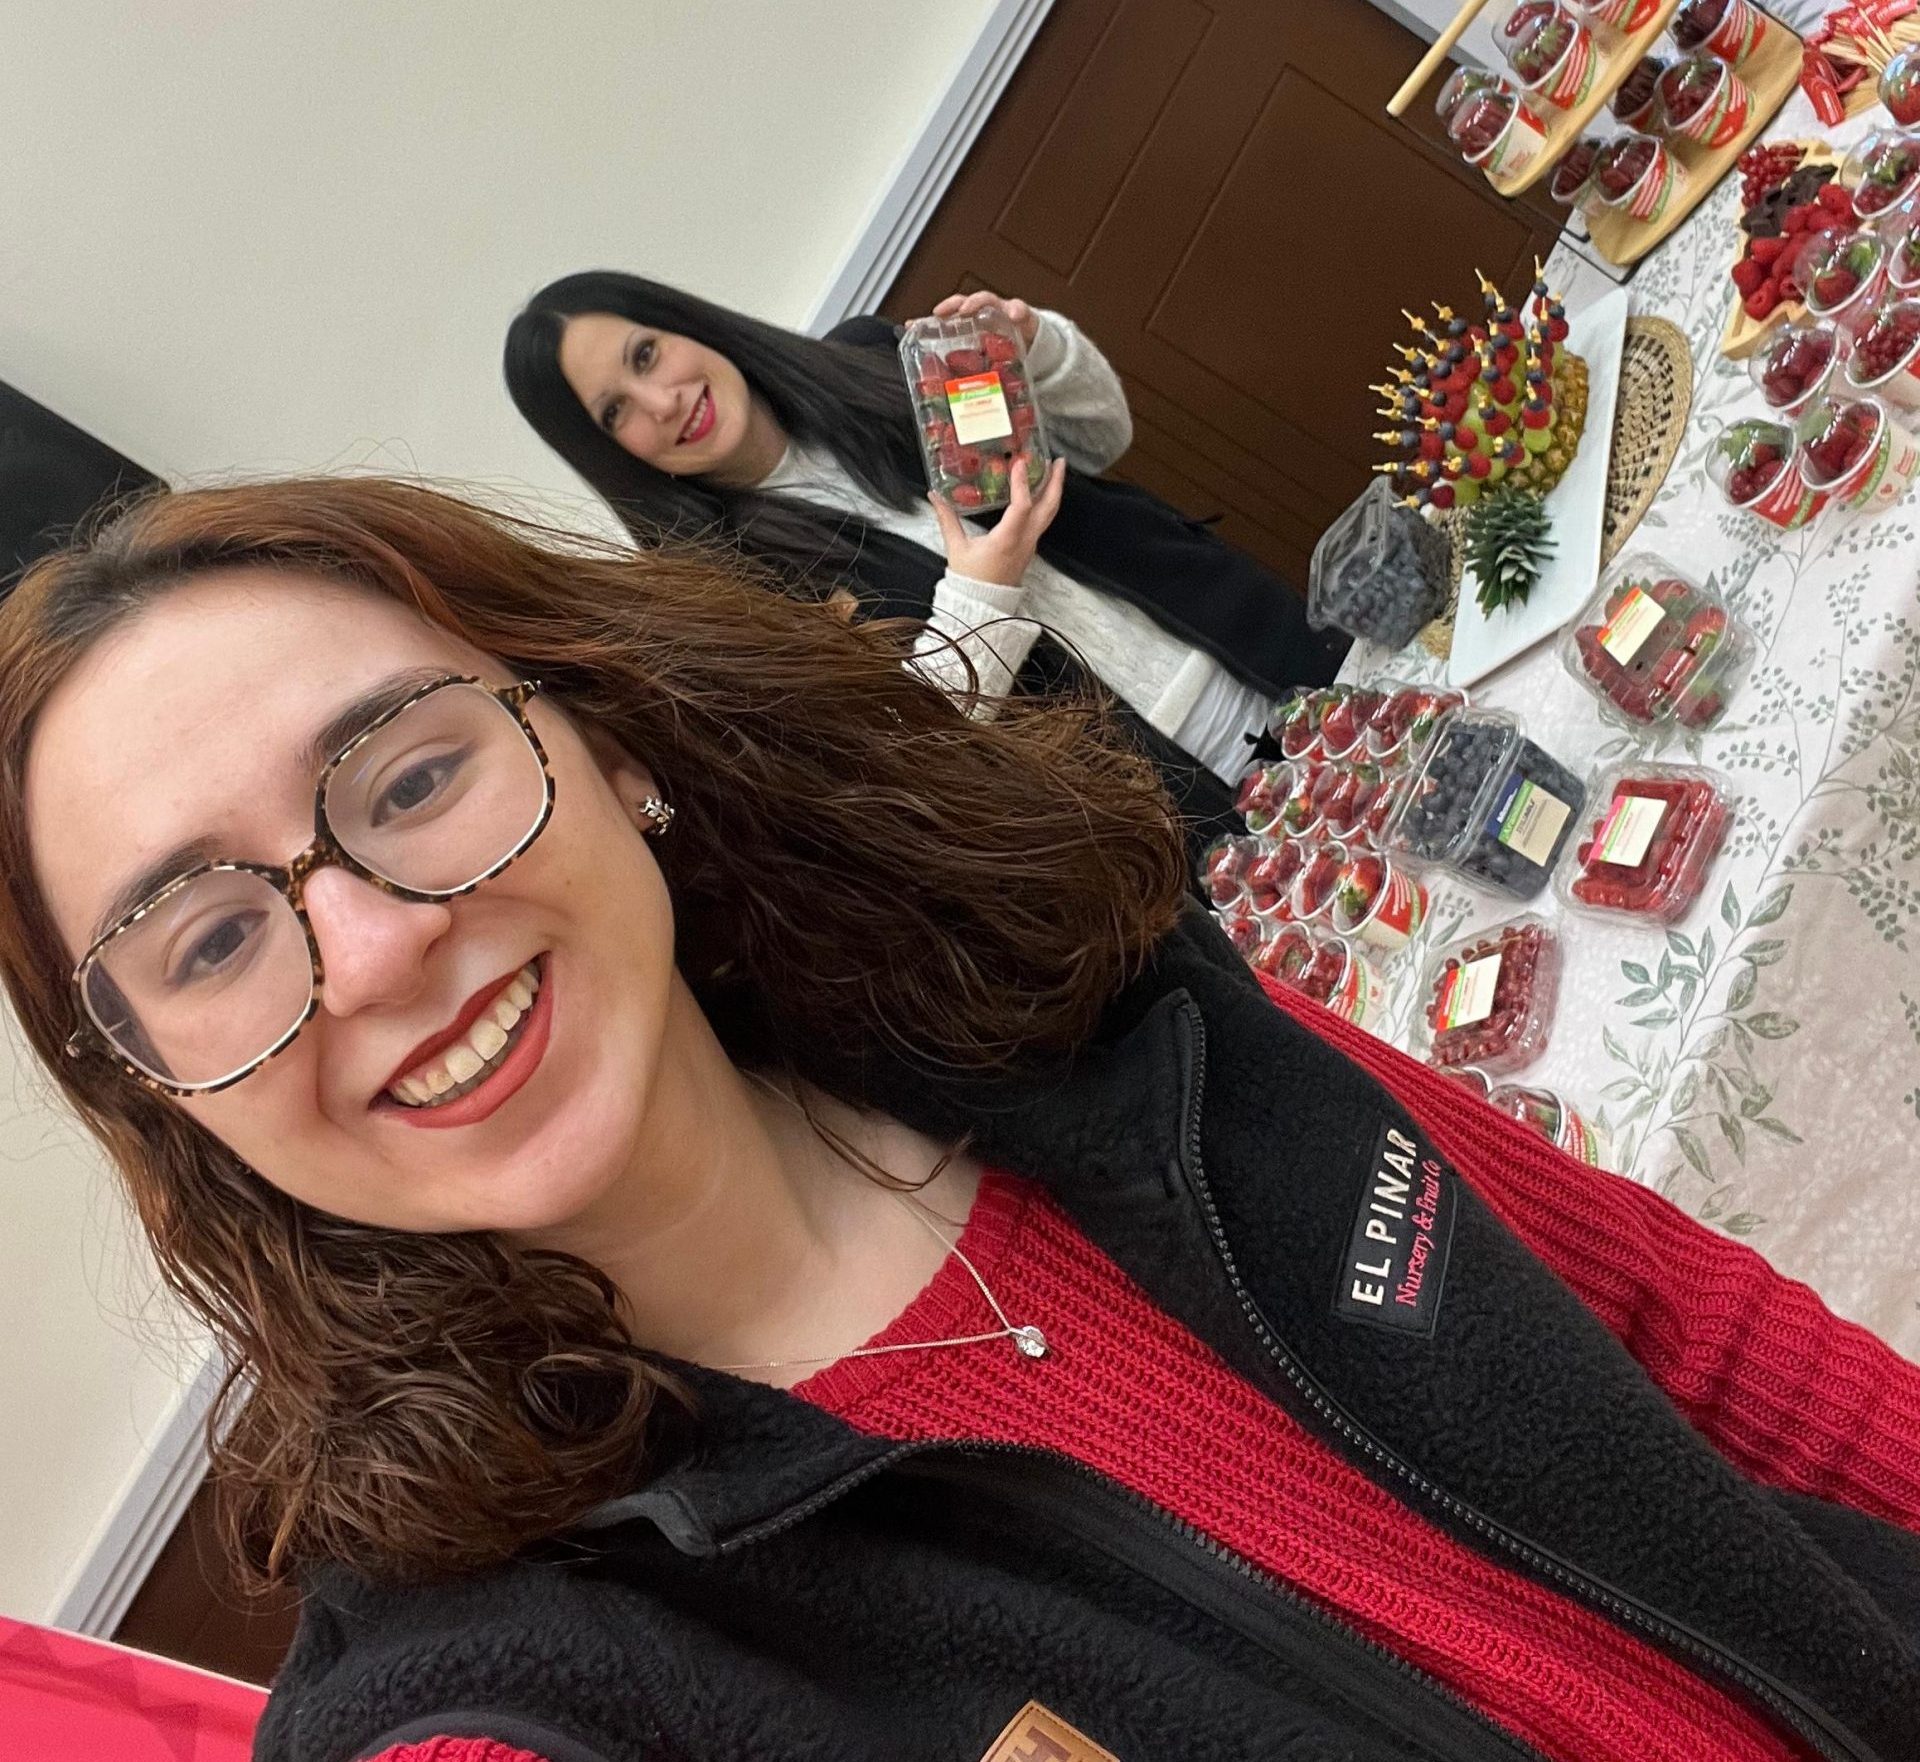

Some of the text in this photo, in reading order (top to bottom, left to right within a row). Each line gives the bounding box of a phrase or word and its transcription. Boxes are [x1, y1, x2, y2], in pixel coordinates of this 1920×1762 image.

[1352, 1128, 1417, 1305] EL PINAR
[1412, 1215, 1434, 1231] &
[1416, 1175, 1441, 1215] Fruit
[1396, 1232, 1435, 1307] Nursery
